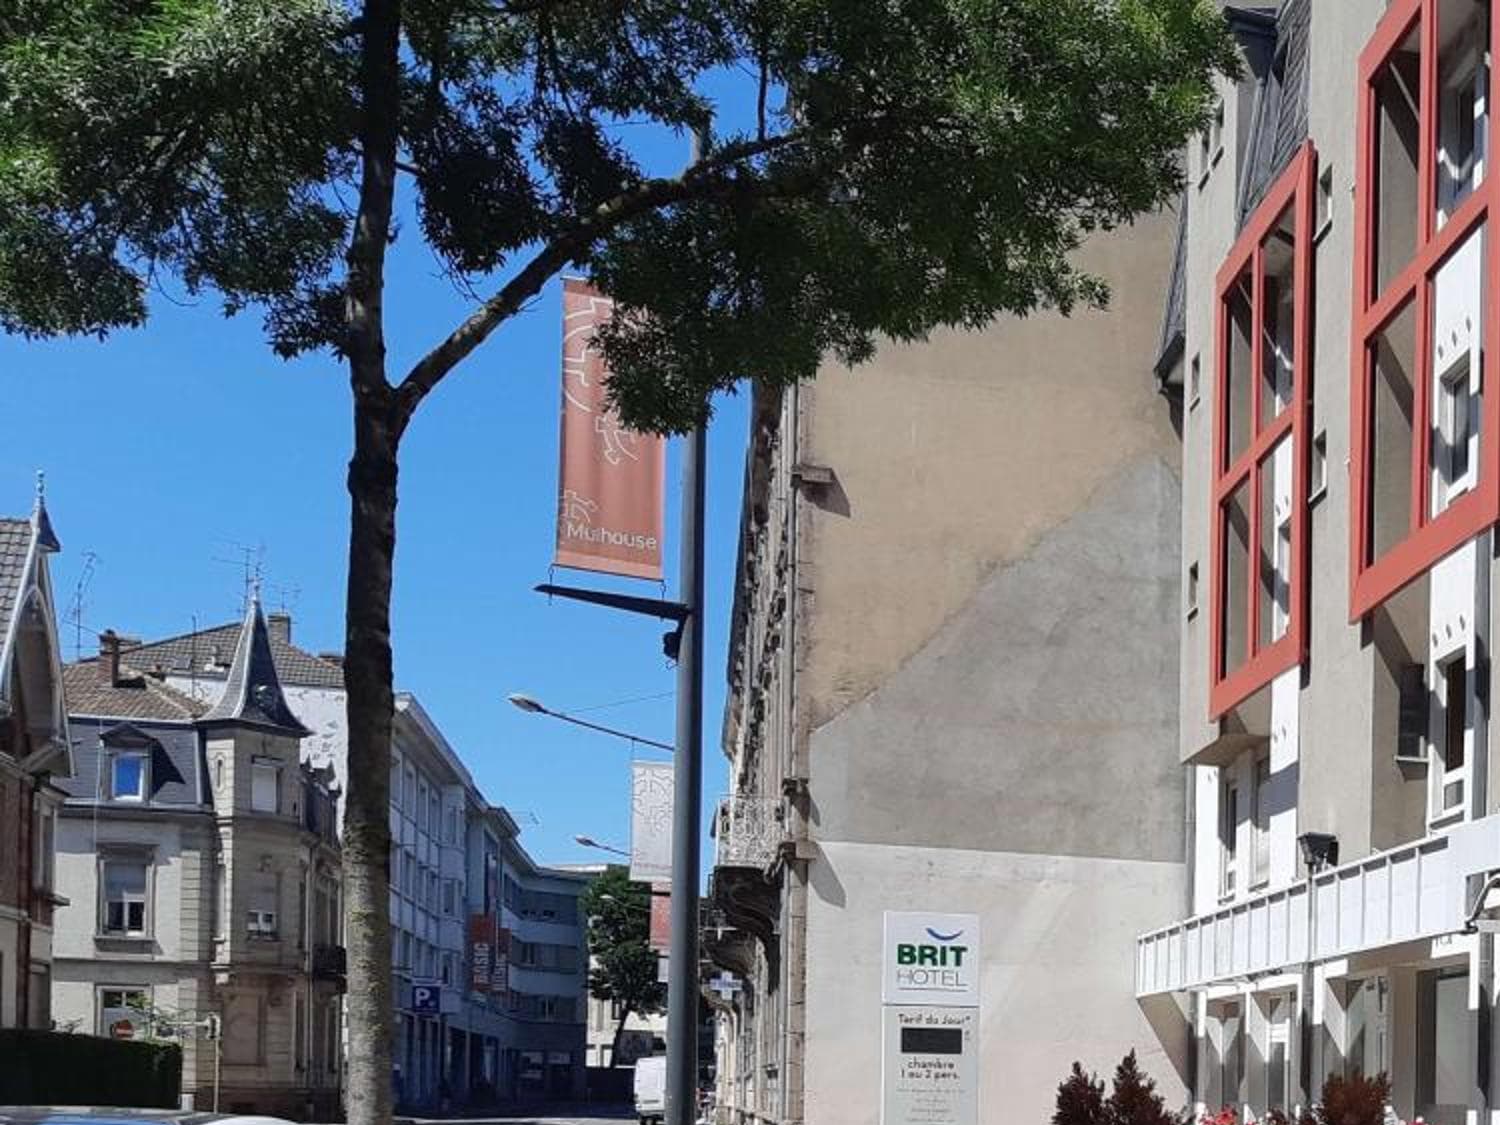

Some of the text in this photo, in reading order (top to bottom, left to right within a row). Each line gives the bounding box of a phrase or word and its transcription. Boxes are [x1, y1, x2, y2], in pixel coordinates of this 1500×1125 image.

[566, 522, 657, 549] Mulhouse
[897, 943, 968, 967] BRIT
[896, 968, 968, 987] HOTEL
[898, 1013, 922, 1024] Tarif
[925, 1013, 939, 1025] du
[907, 1055, 955, 1070] chambre
